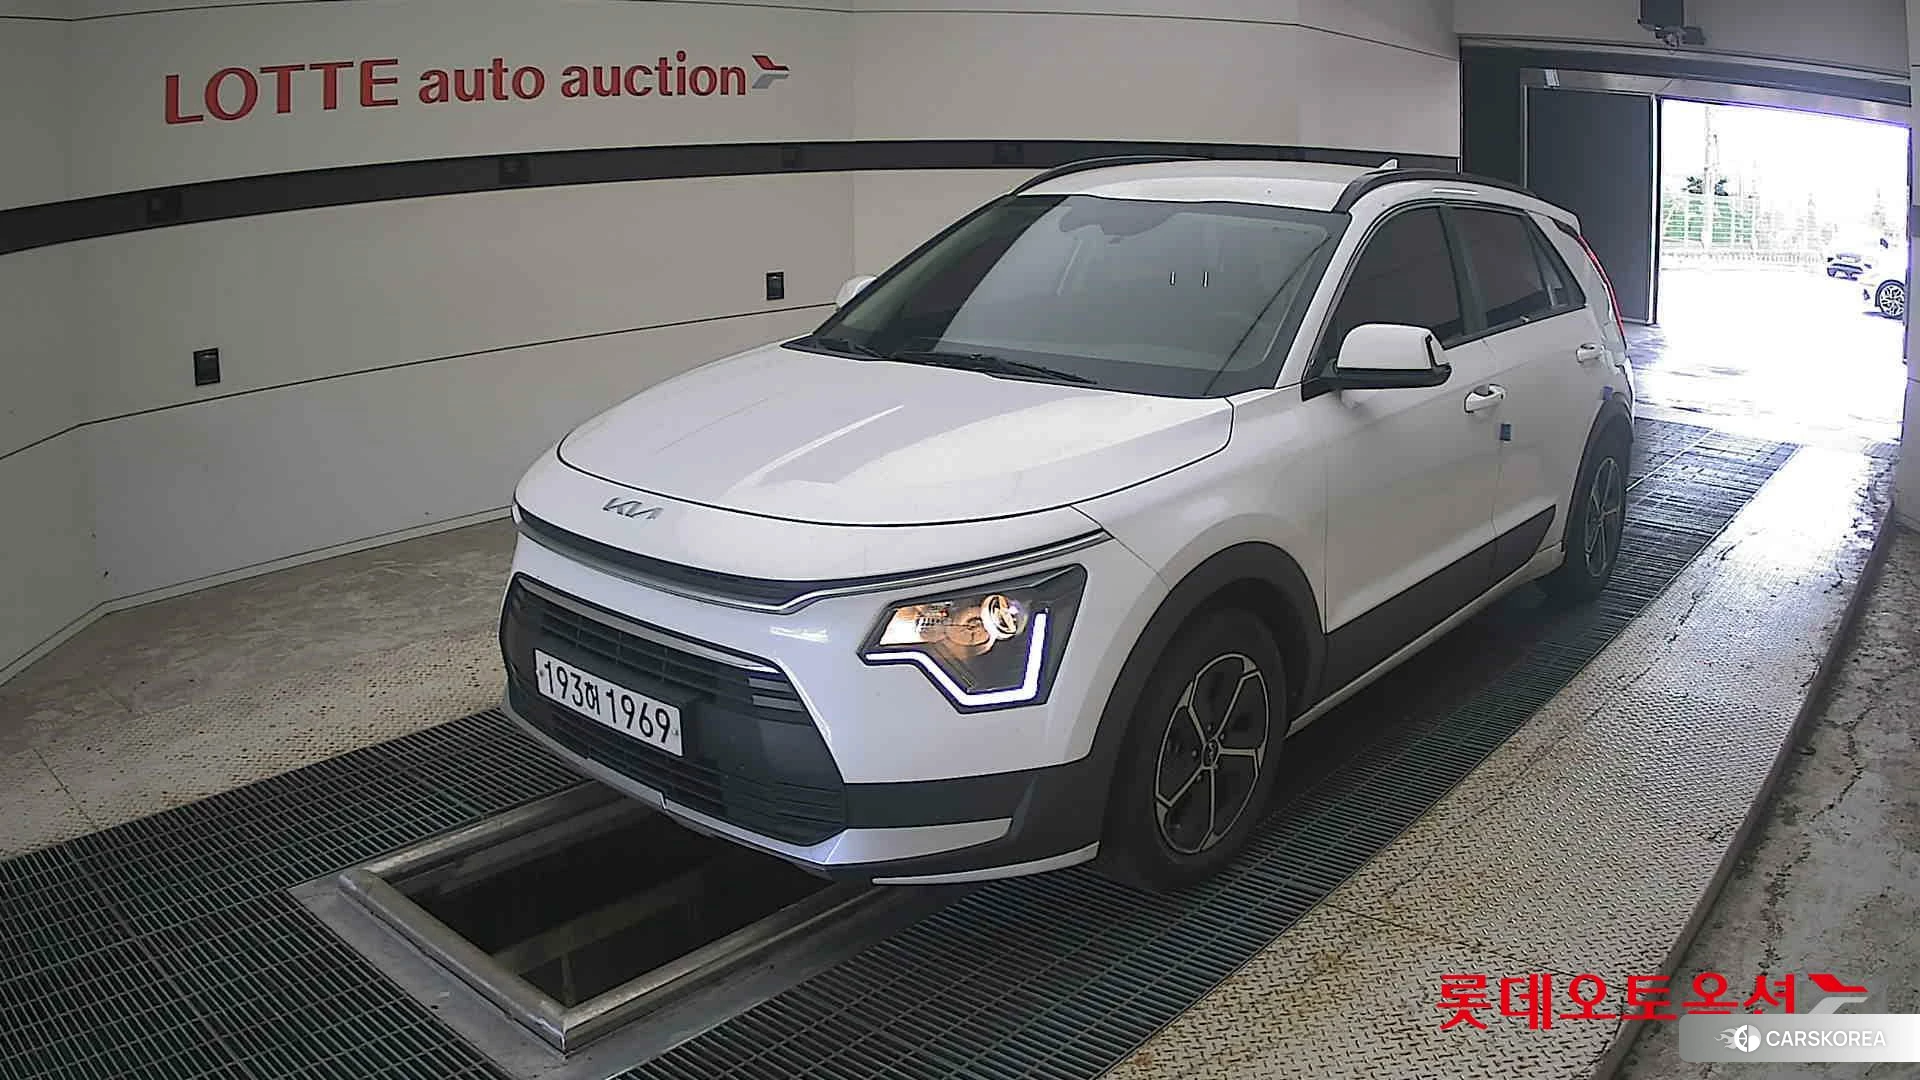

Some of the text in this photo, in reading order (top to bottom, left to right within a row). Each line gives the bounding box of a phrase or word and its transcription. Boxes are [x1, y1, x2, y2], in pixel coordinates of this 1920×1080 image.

[164, 50, 748, 125] LOTTE auto auction
[602, 496, 664, 520] KIA
[606, 688, 671, 744] 1969
